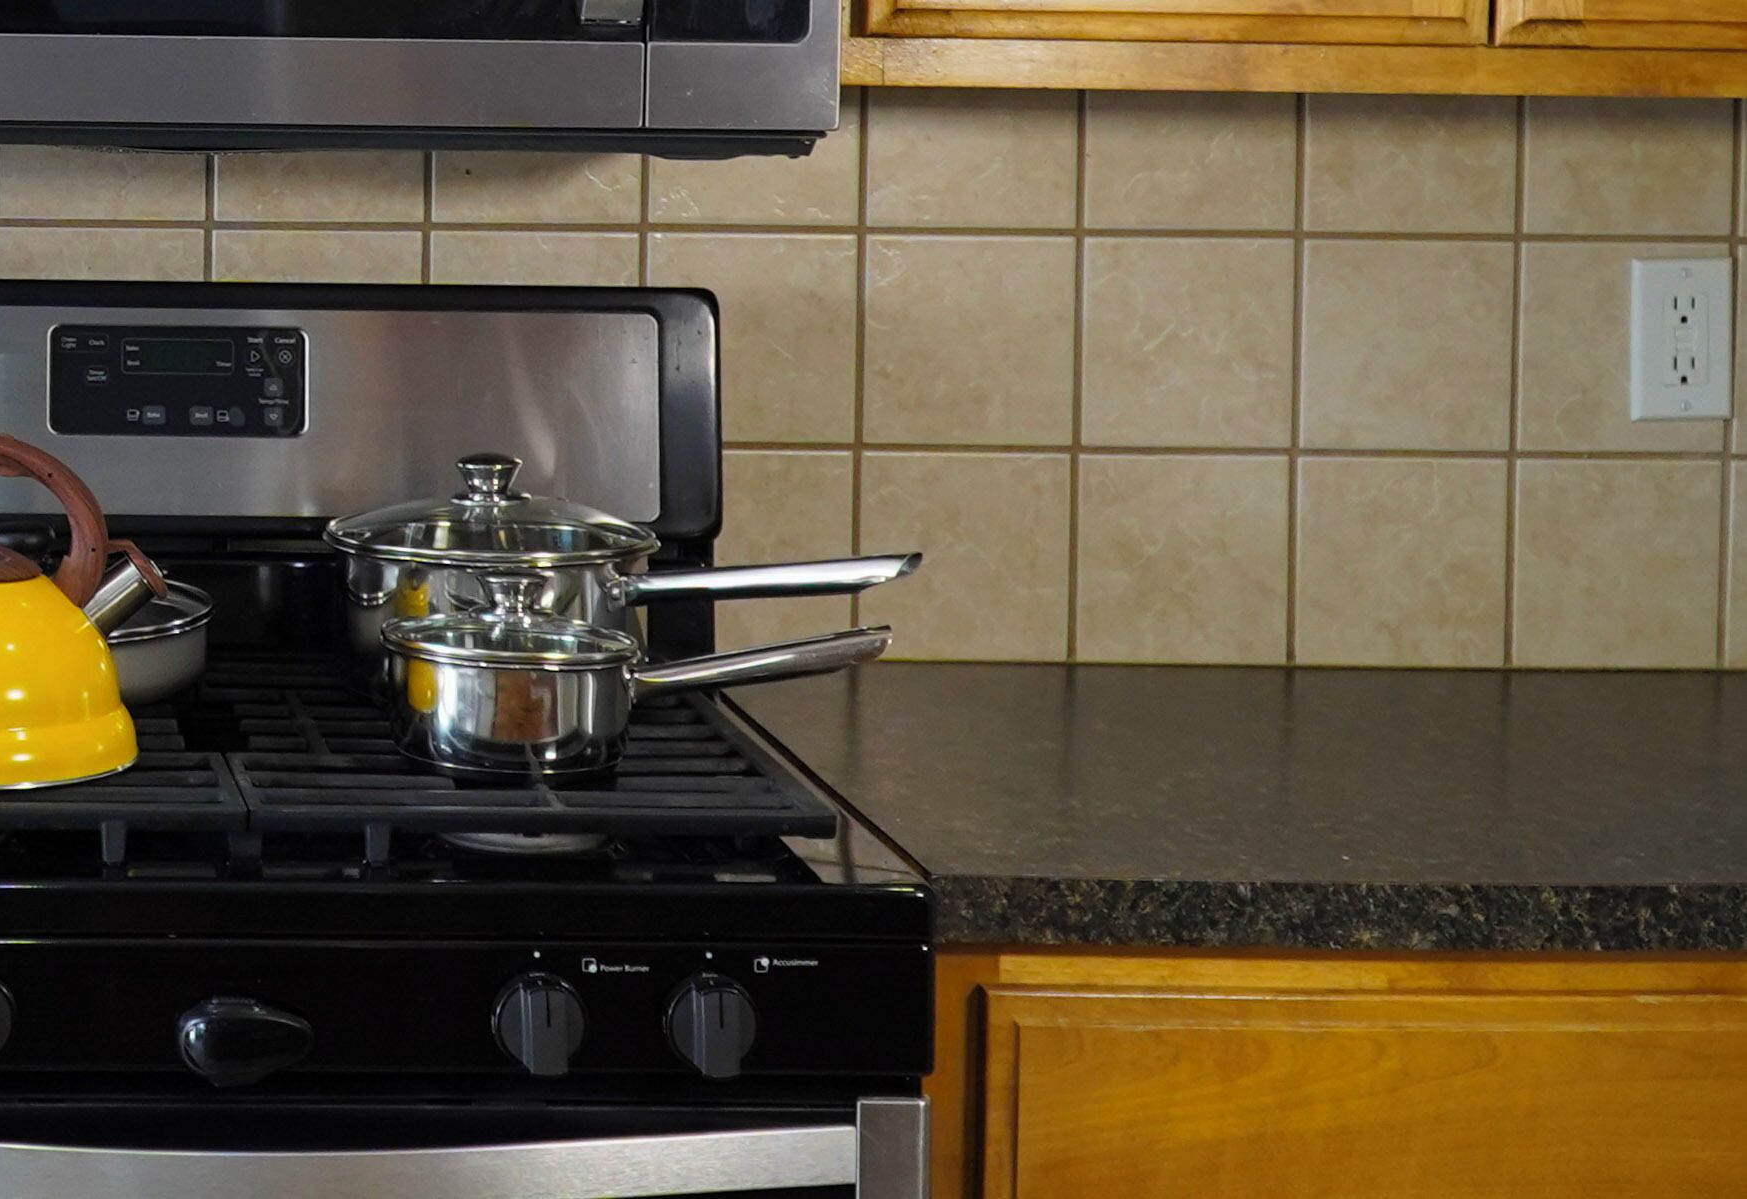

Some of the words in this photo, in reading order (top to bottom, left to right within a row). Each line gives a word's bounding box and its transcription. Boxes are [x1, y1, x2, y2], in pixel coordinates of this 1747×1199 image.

[274, 336, 296, 345] Cancel
[600, 964, 623, 973] Power
[625, 964, 650, 974] Burner
